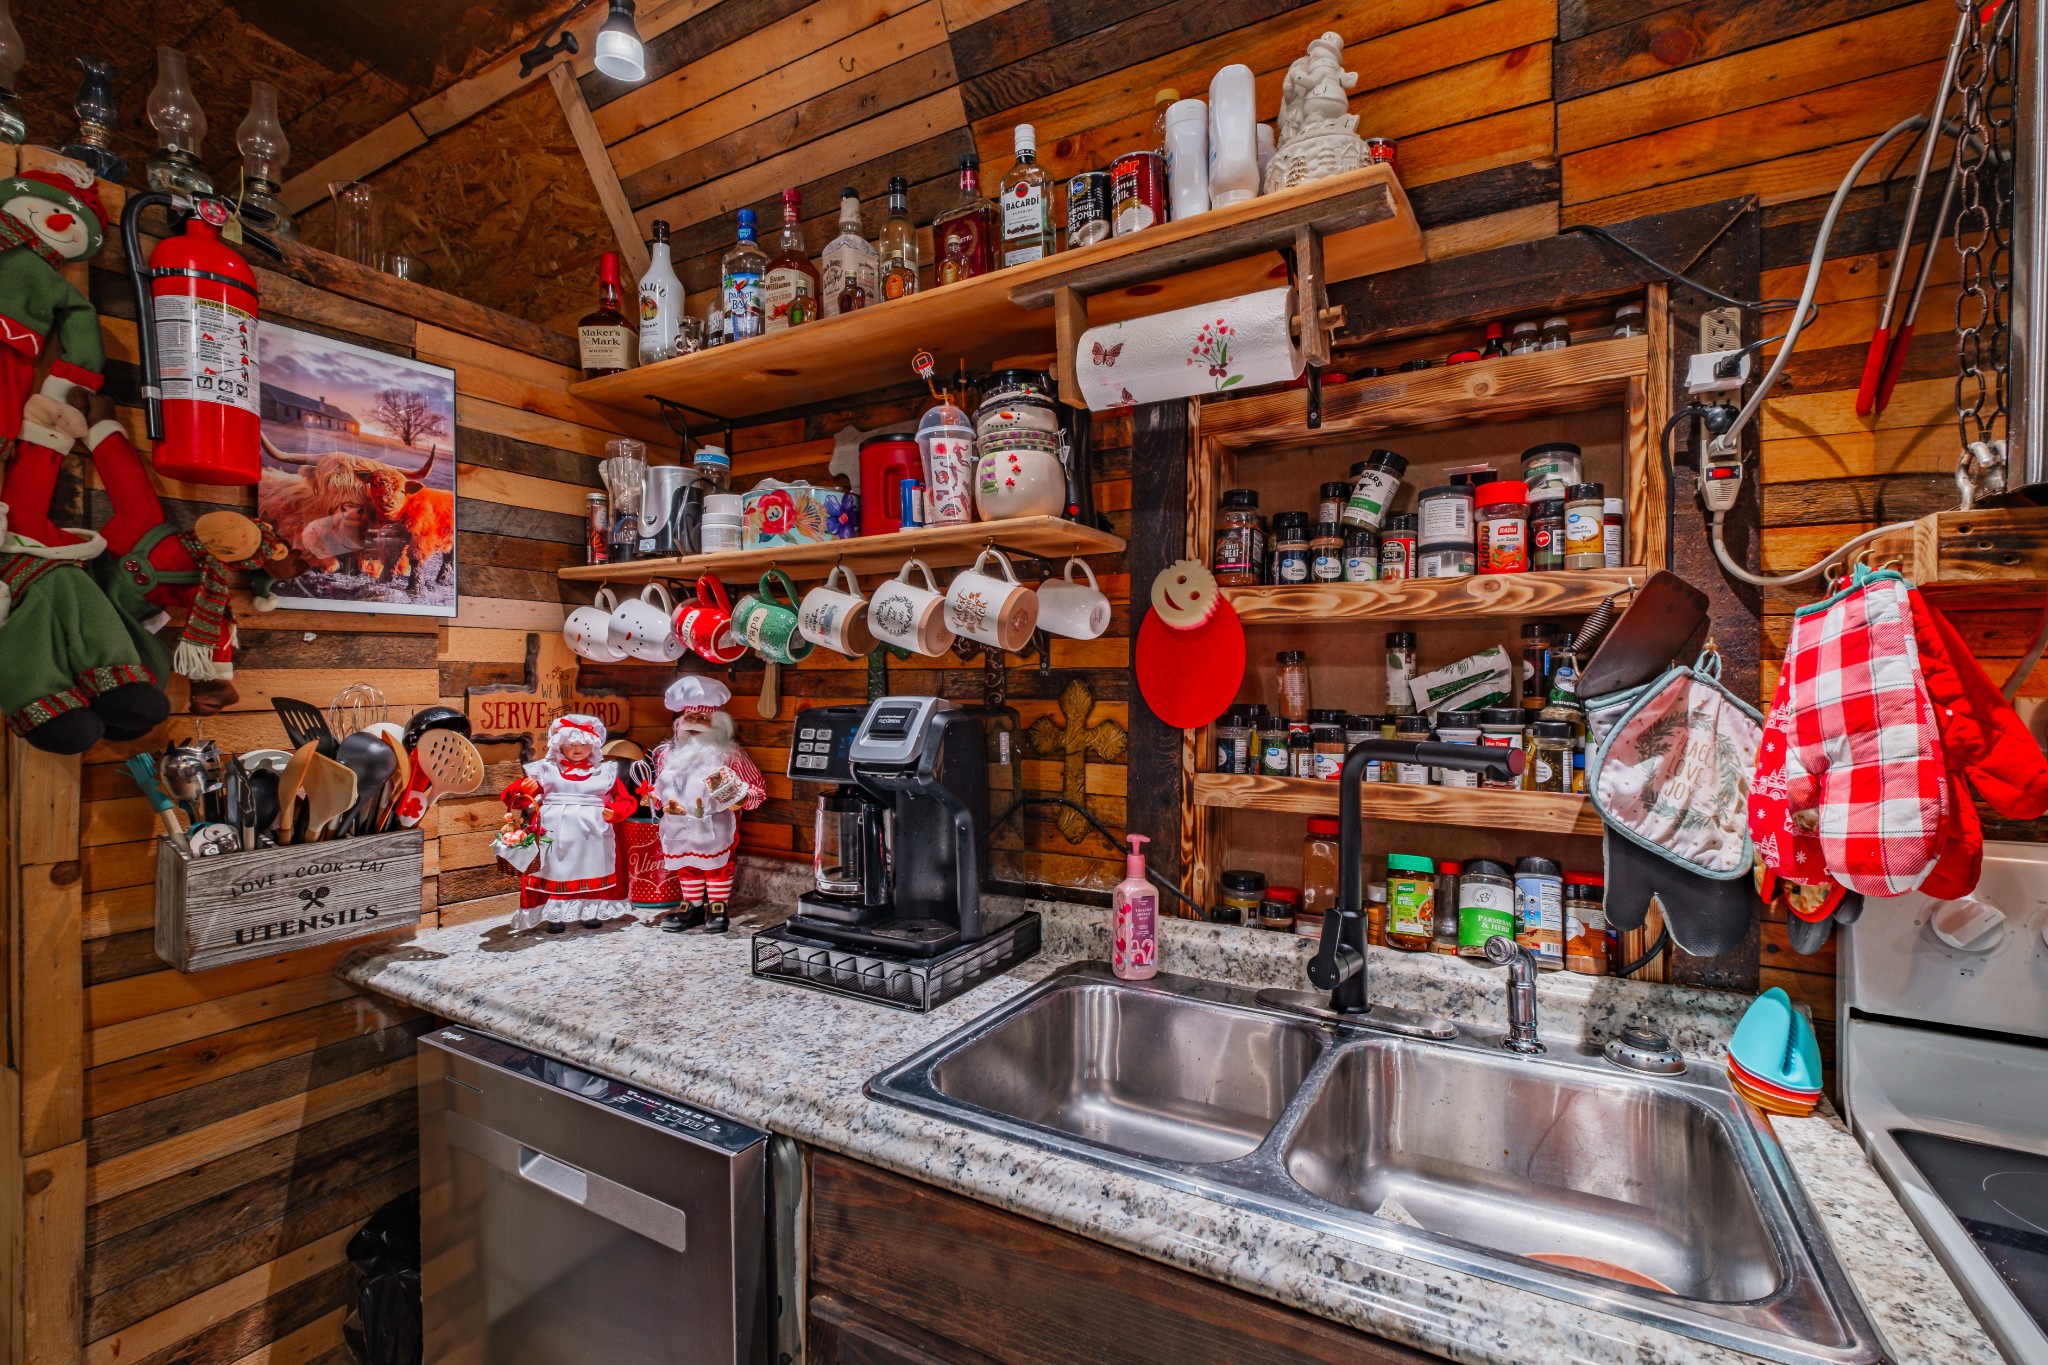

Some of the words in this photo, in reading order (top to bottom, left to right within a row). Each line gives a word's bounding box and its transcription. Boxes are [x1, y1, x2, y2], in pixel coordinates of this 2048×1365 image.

[1006, 194, 1040, 212] BACARDÍ
[766, 282, 791, 292] Williams
[770, 276, 786, 284] Evan
[729, 292, 754, 302] PARROT
[732, 300, 748, 310] BAY
[582, 329, 620, 337] Maker's
[591, 338, 620, 346] Mark
[1224, 549, 1239, 557] HEAT
[1480, 526, 1490, 569] Adobo
[748, 616, 760, 643] Papa
[541, 684, 553, 699] WE
[556, 684, 574, 700] WILL
[480, 702, 547, 729] SERVE
[1668, 756, 1704, 786] LOVE
[1664, 780, 1695, 801] JOY
[630, 853, 664, 874] Uten
[231, 874, 276, 899] LOVE
[296, 862, 343, 878] COOK
[359, 861, 388, 873] EAT
[235, 904, 379, 945] UTENSILS
[1478, 914, 1512, 928] PARMESAN
[1492, 924, 1509, 933] HERB
